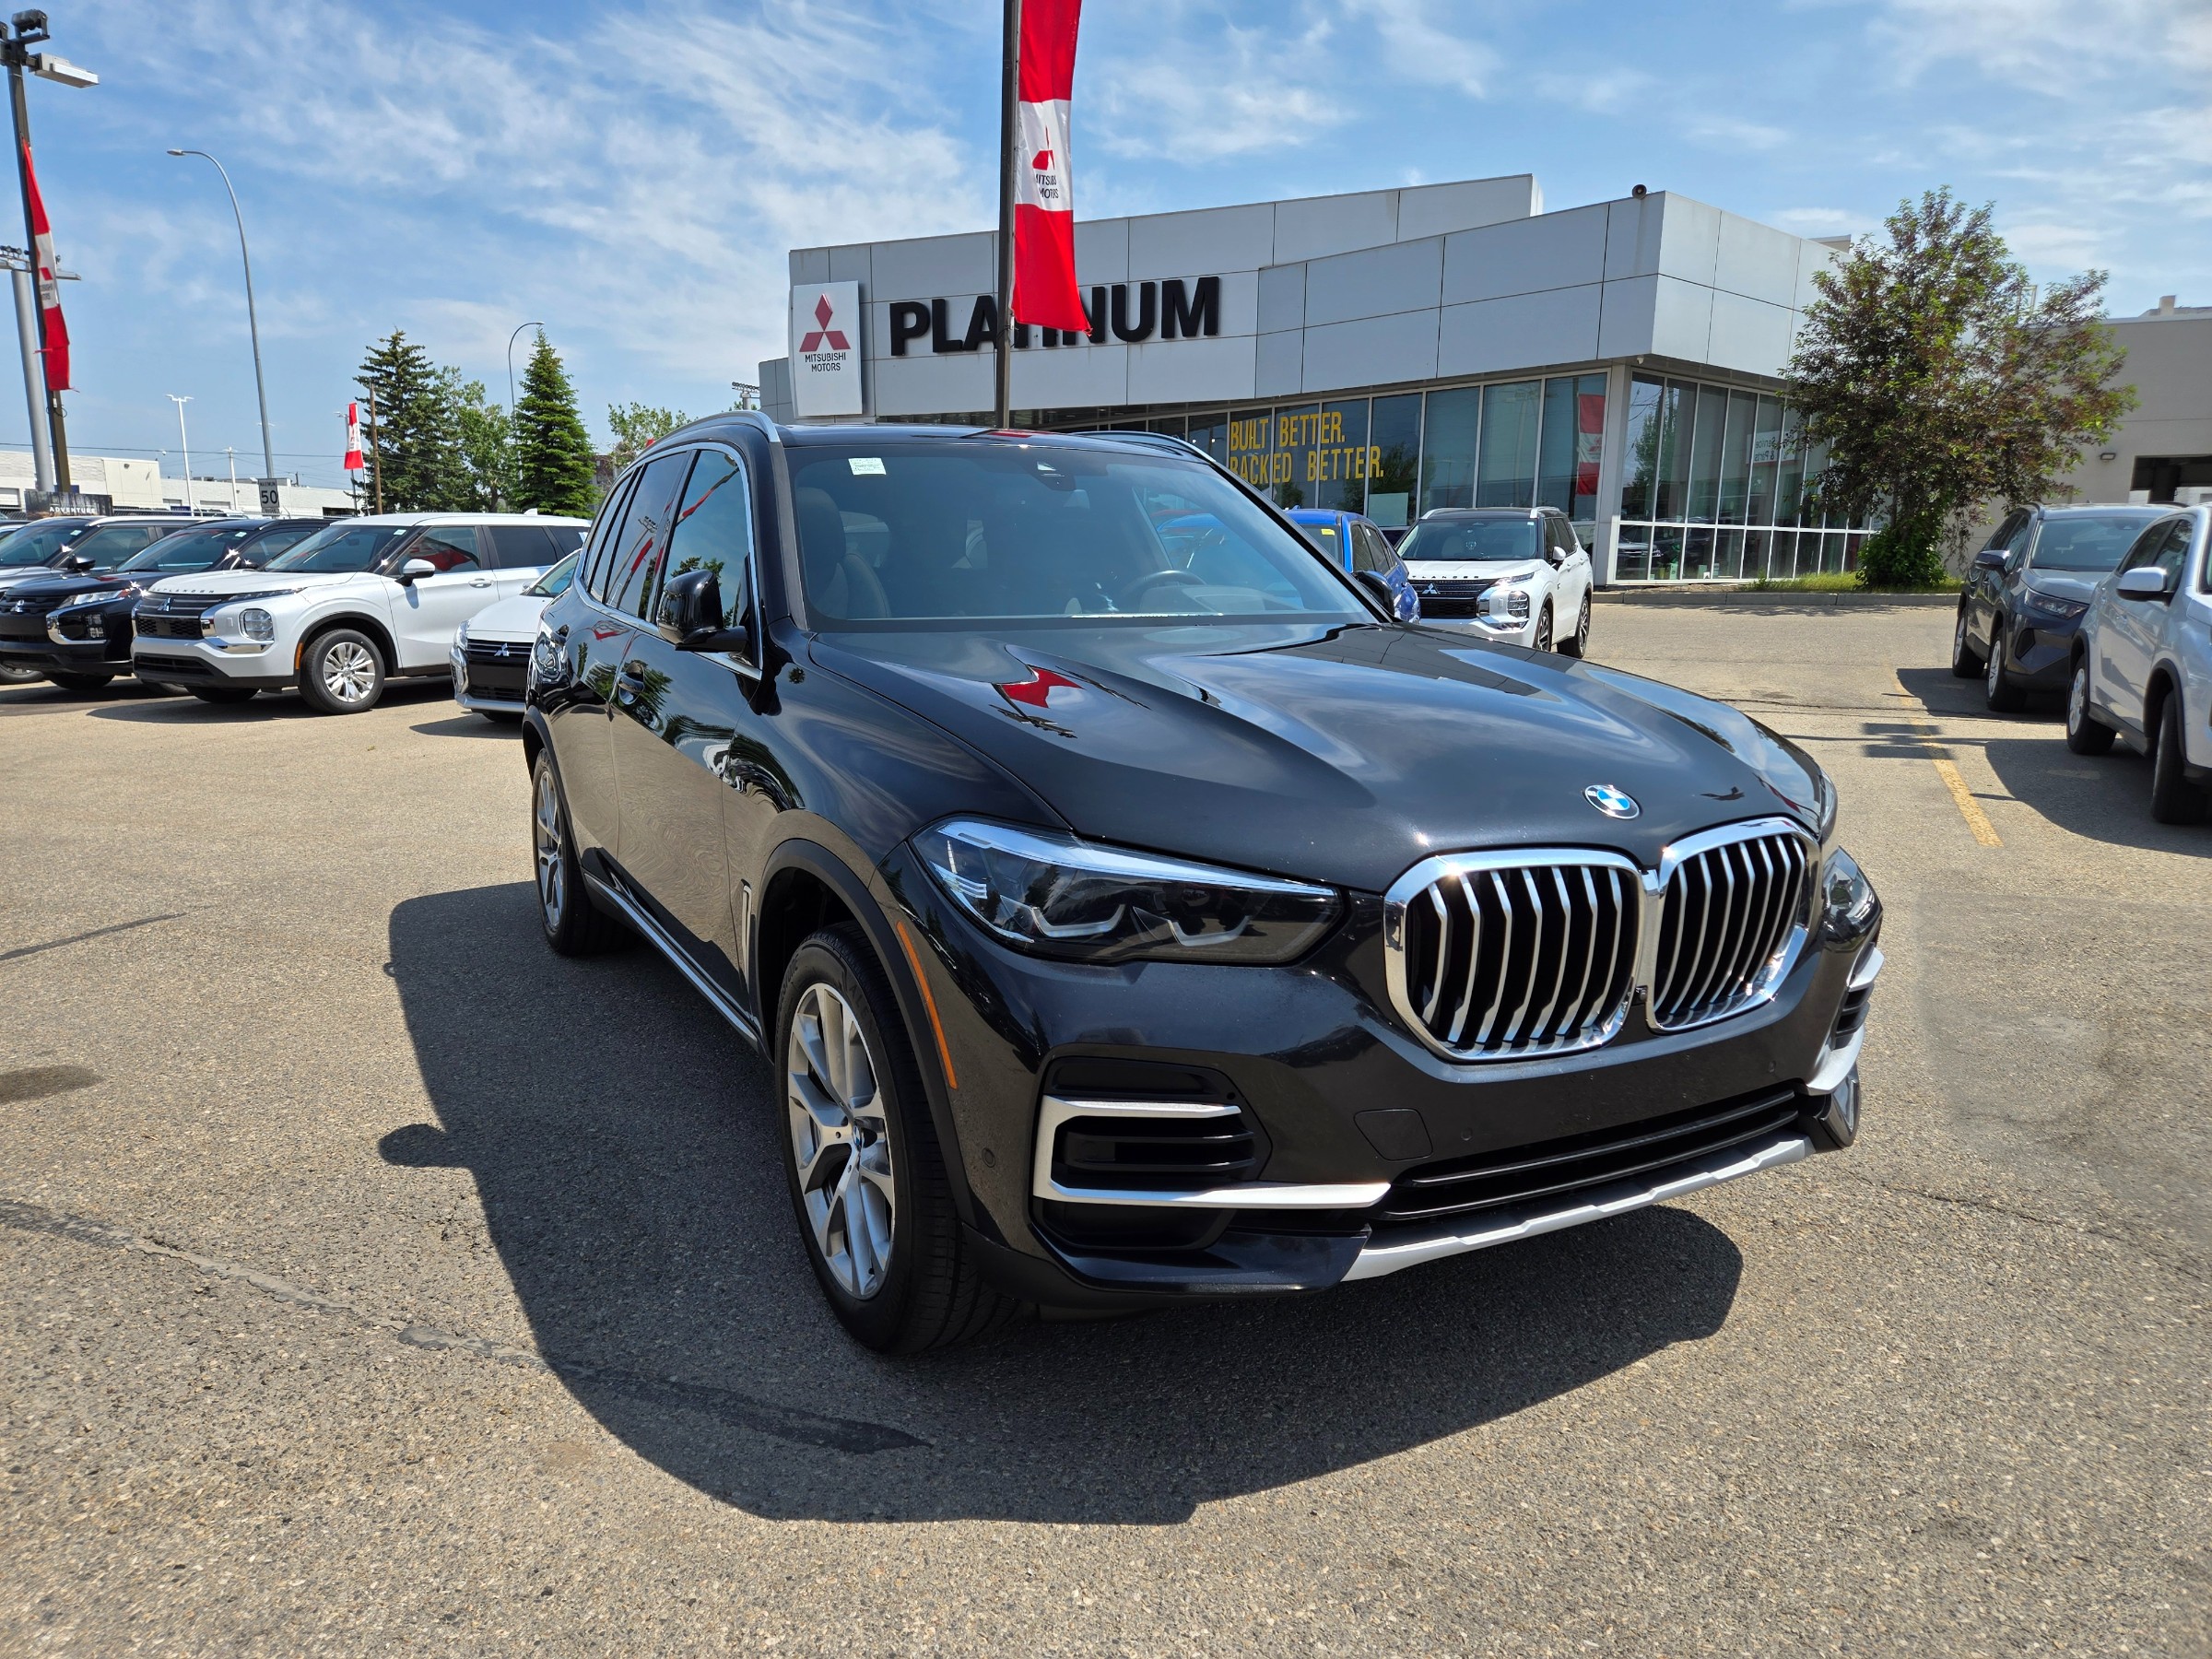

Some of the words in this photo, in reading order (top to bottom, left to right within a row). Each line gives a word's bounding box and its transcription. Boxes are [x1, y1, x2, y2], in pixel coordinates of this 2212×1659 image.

[889, 276, 1220, 357] PLANUM
[805, 352, 846, 362] MITSUBISHI
[811, 363, 841, 372] MOTORS
[1230, 418, 1269, 452] BUILT
[1278, 411, 1346, 448] BETTER.
[1307, 445, 1384, 482] BETTER.
[261, 489, 278, 504] 50
[49, 506, 96, 514] ADVENTURE
